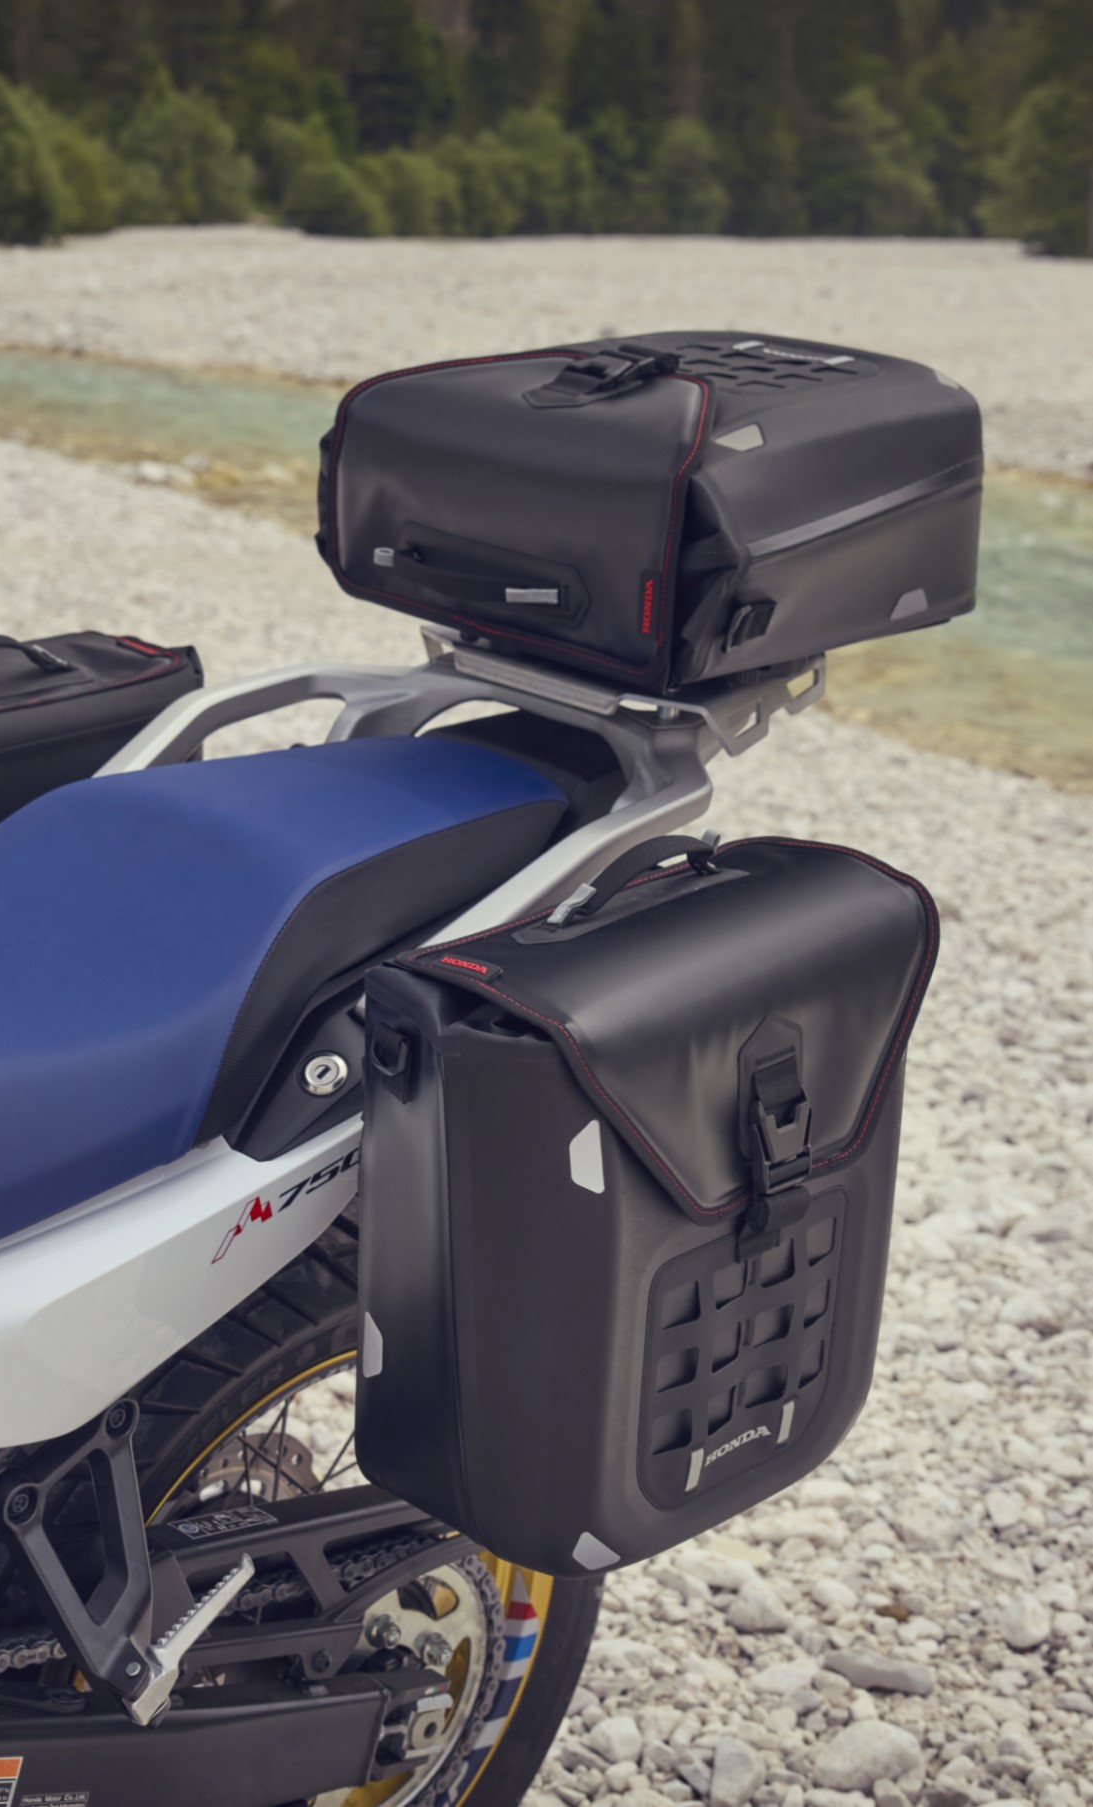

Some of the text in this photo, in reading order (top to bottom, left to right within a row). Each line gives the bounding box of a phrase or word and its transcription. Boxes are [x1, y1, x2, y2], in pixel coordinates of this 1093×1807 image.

[642, 579, 653, 634] HONDA
[440, 956, 487, 974] HONDA
[704, 1425, 771, 1467] HONDA
